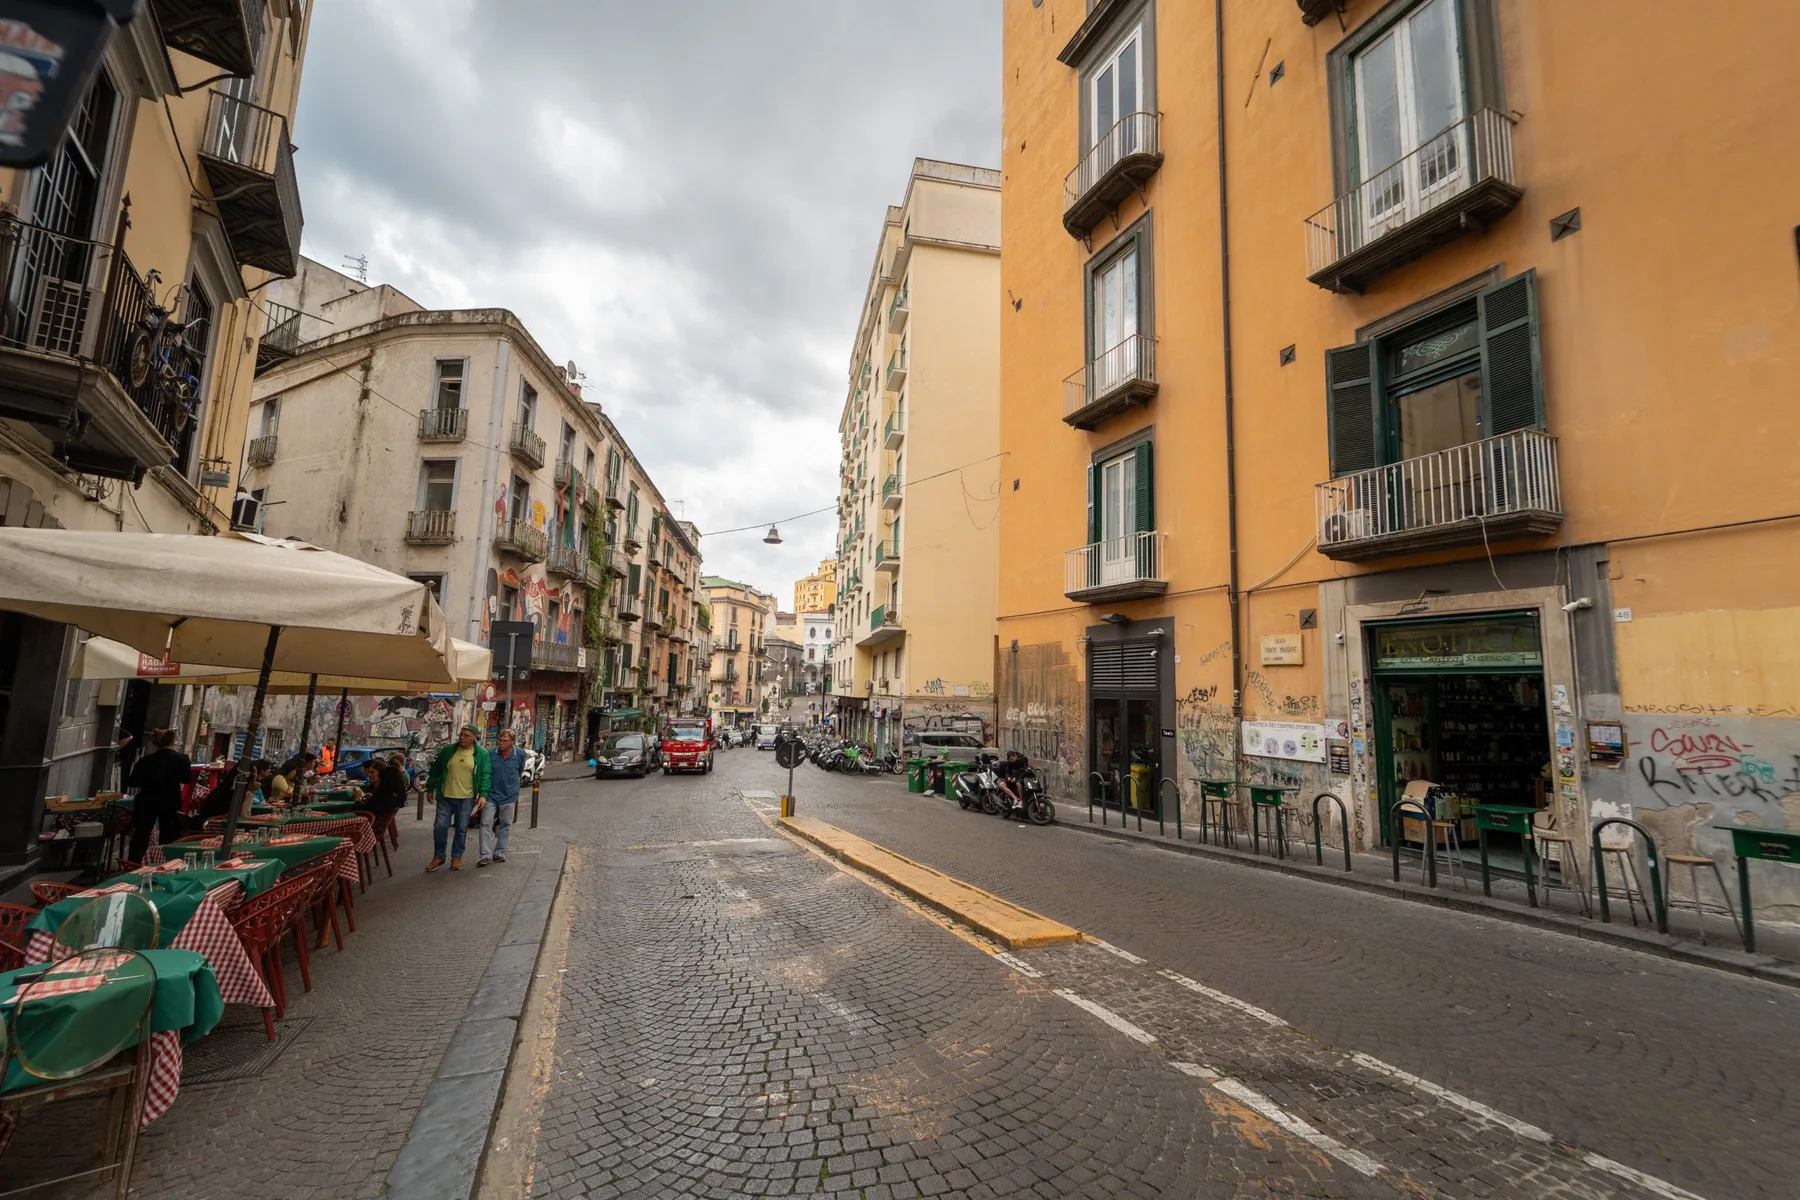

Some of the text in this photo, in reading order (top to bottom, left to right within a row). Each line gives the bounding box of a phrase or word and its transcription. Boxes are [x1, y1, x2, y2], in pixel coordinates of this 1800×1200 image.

[1616, 611, 1630, 619] 48
[1384, 627, 1529, 655] ENOTECA
[1465, 654, 1511, 662] Storico
